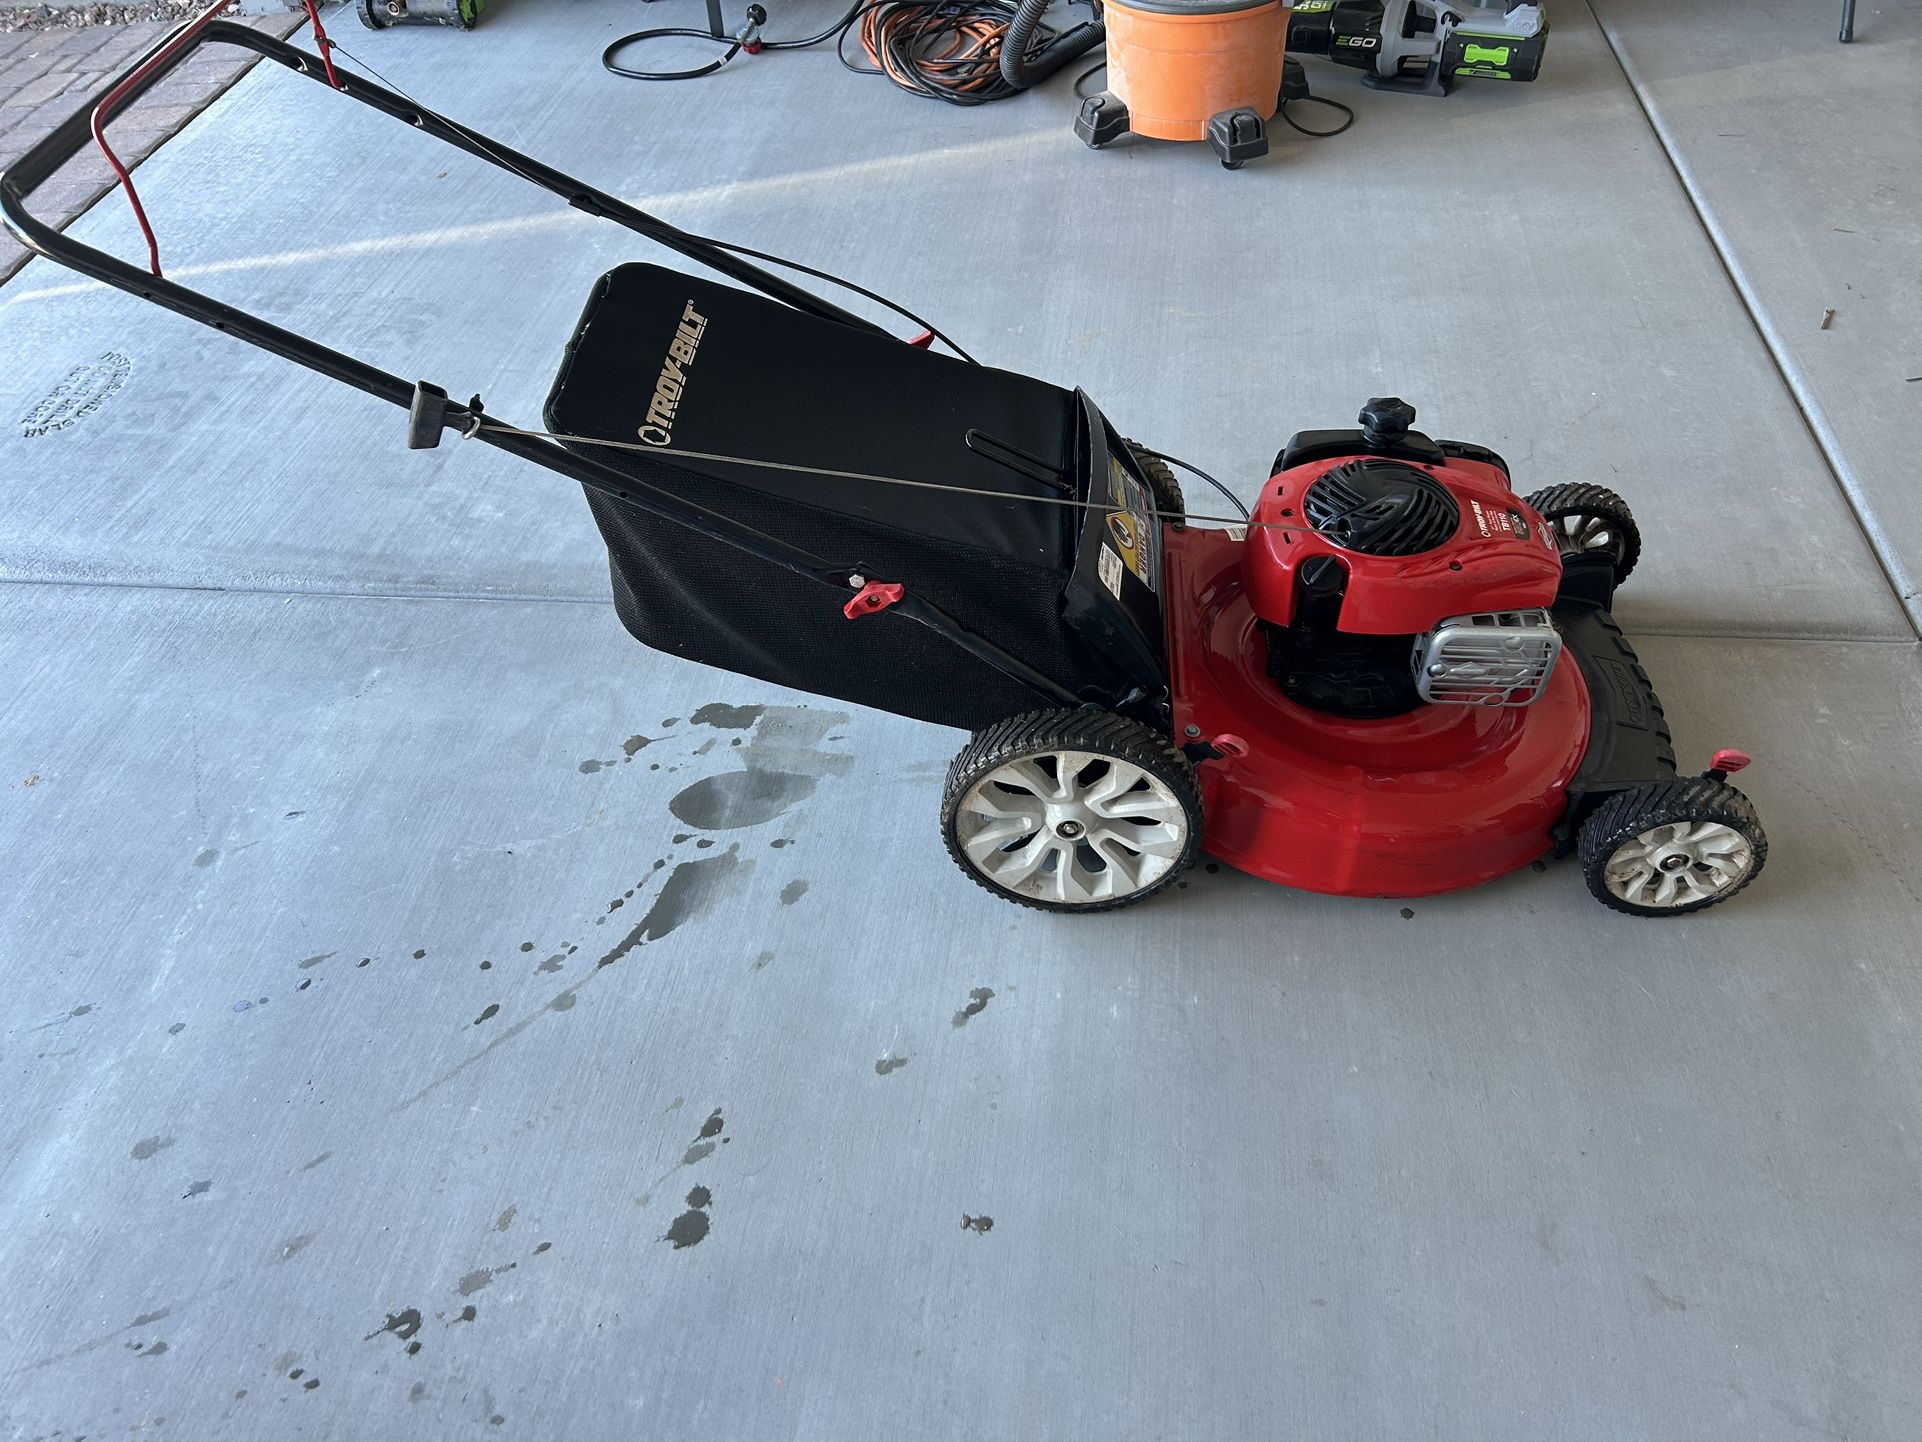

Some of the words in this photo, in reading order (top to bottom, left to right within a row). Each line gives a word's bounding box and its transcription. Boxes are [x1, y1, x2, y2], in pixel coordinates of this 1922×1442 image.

[1336, 35, 1377, 48] EGO
[645, 304, 707, 430] TROY-BILT
[24, 418, 75, 438] SLAB
